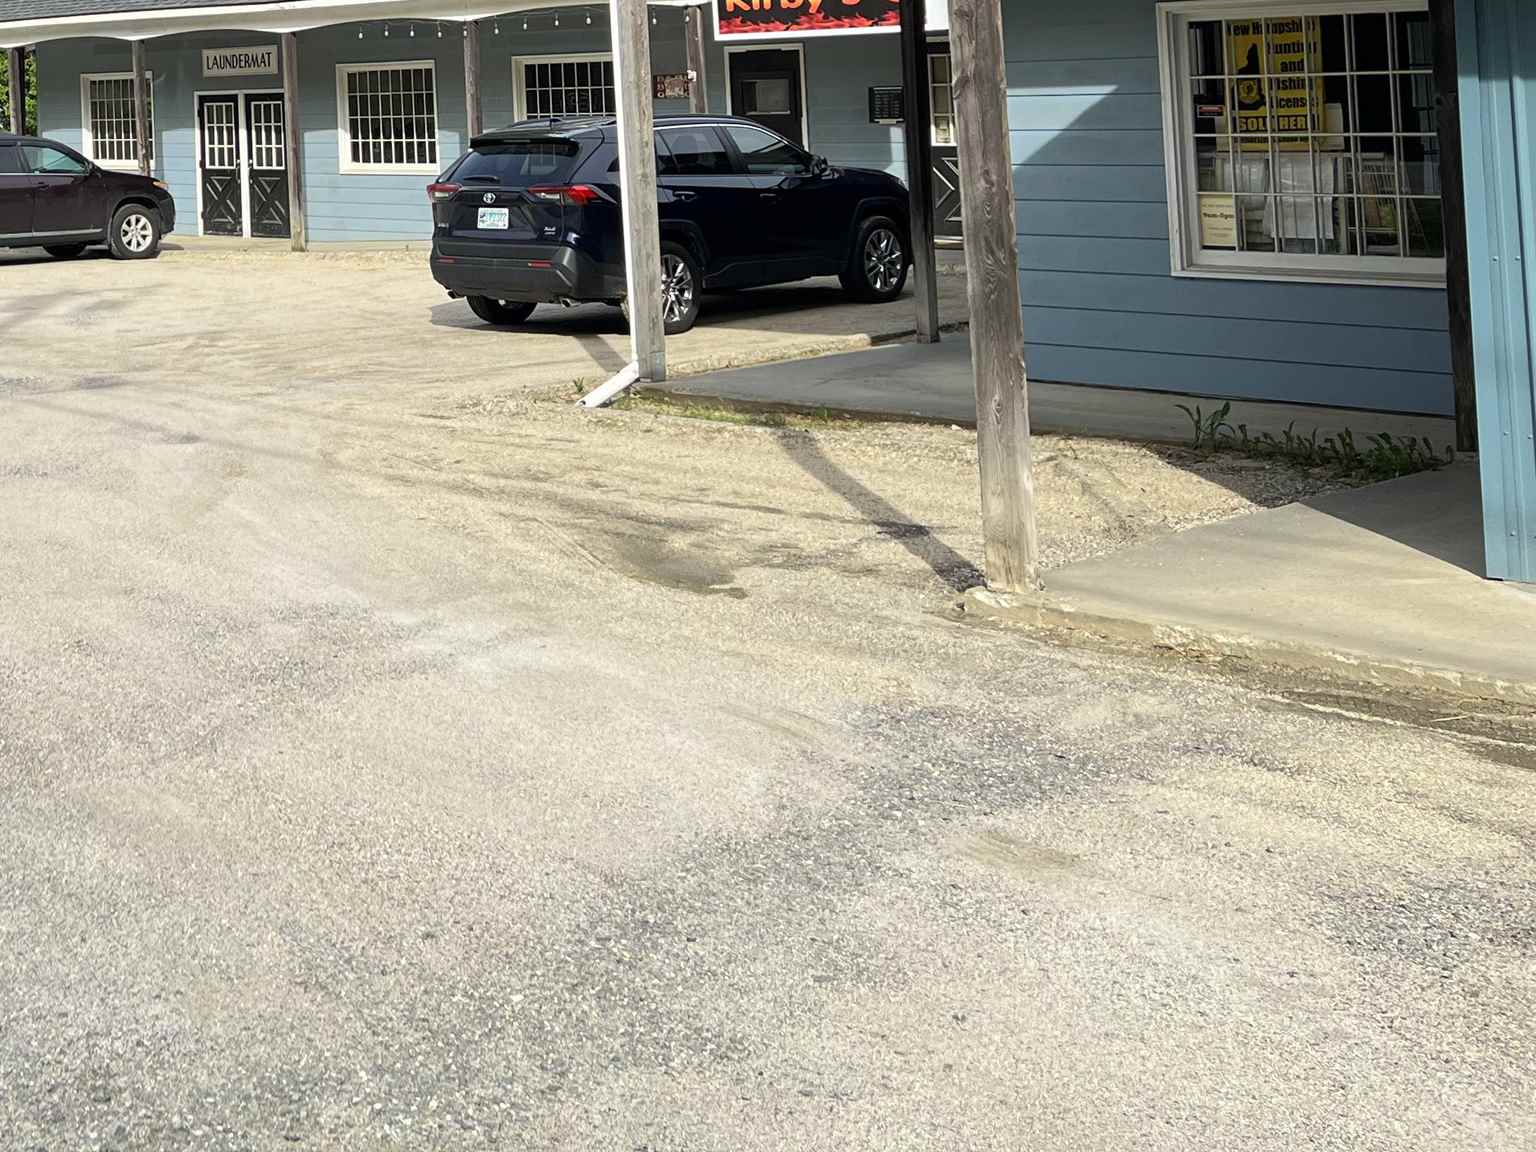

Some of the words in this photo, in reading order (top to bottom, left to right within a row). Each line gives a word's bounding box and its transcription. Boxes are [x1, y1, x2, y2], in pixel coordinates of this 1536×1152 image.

[1228, 22, 1250, 36] ew
[206, 52, 272, 70] LAUNDERMAT
[1239, 117, 1276, 131] SOL
[1279, 116, 1316, 130] HER
